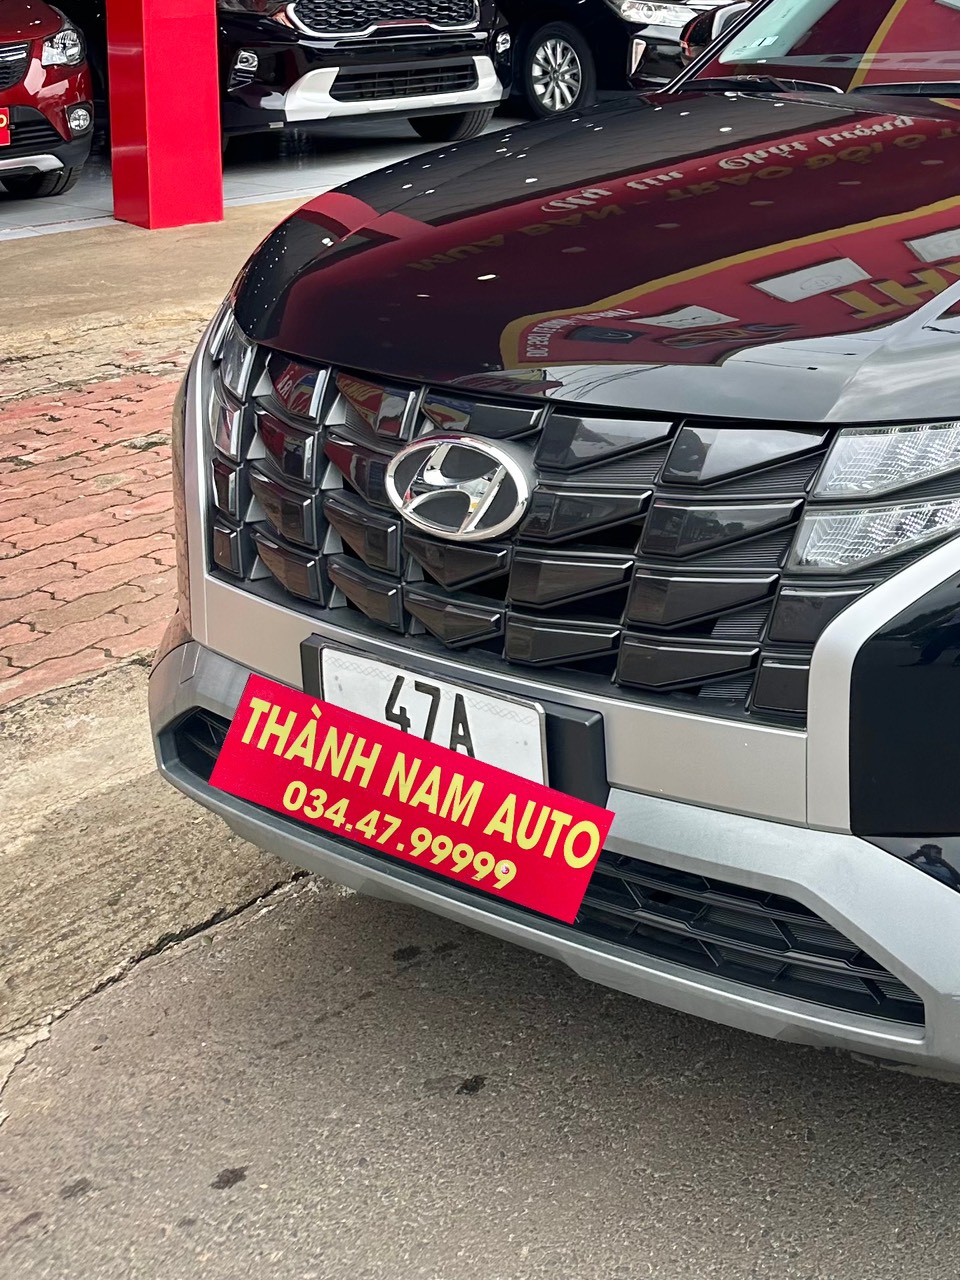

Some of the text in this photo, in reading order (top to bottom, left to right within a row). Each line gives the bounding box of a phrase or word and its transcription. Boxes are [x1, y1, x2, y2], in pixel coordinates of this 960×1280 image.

[384, 675, 476, 758] 47A
[240, 696, 601, 870] THÀNH NAM AUTO
[282, 780, 518, 890] 034.47.99999
